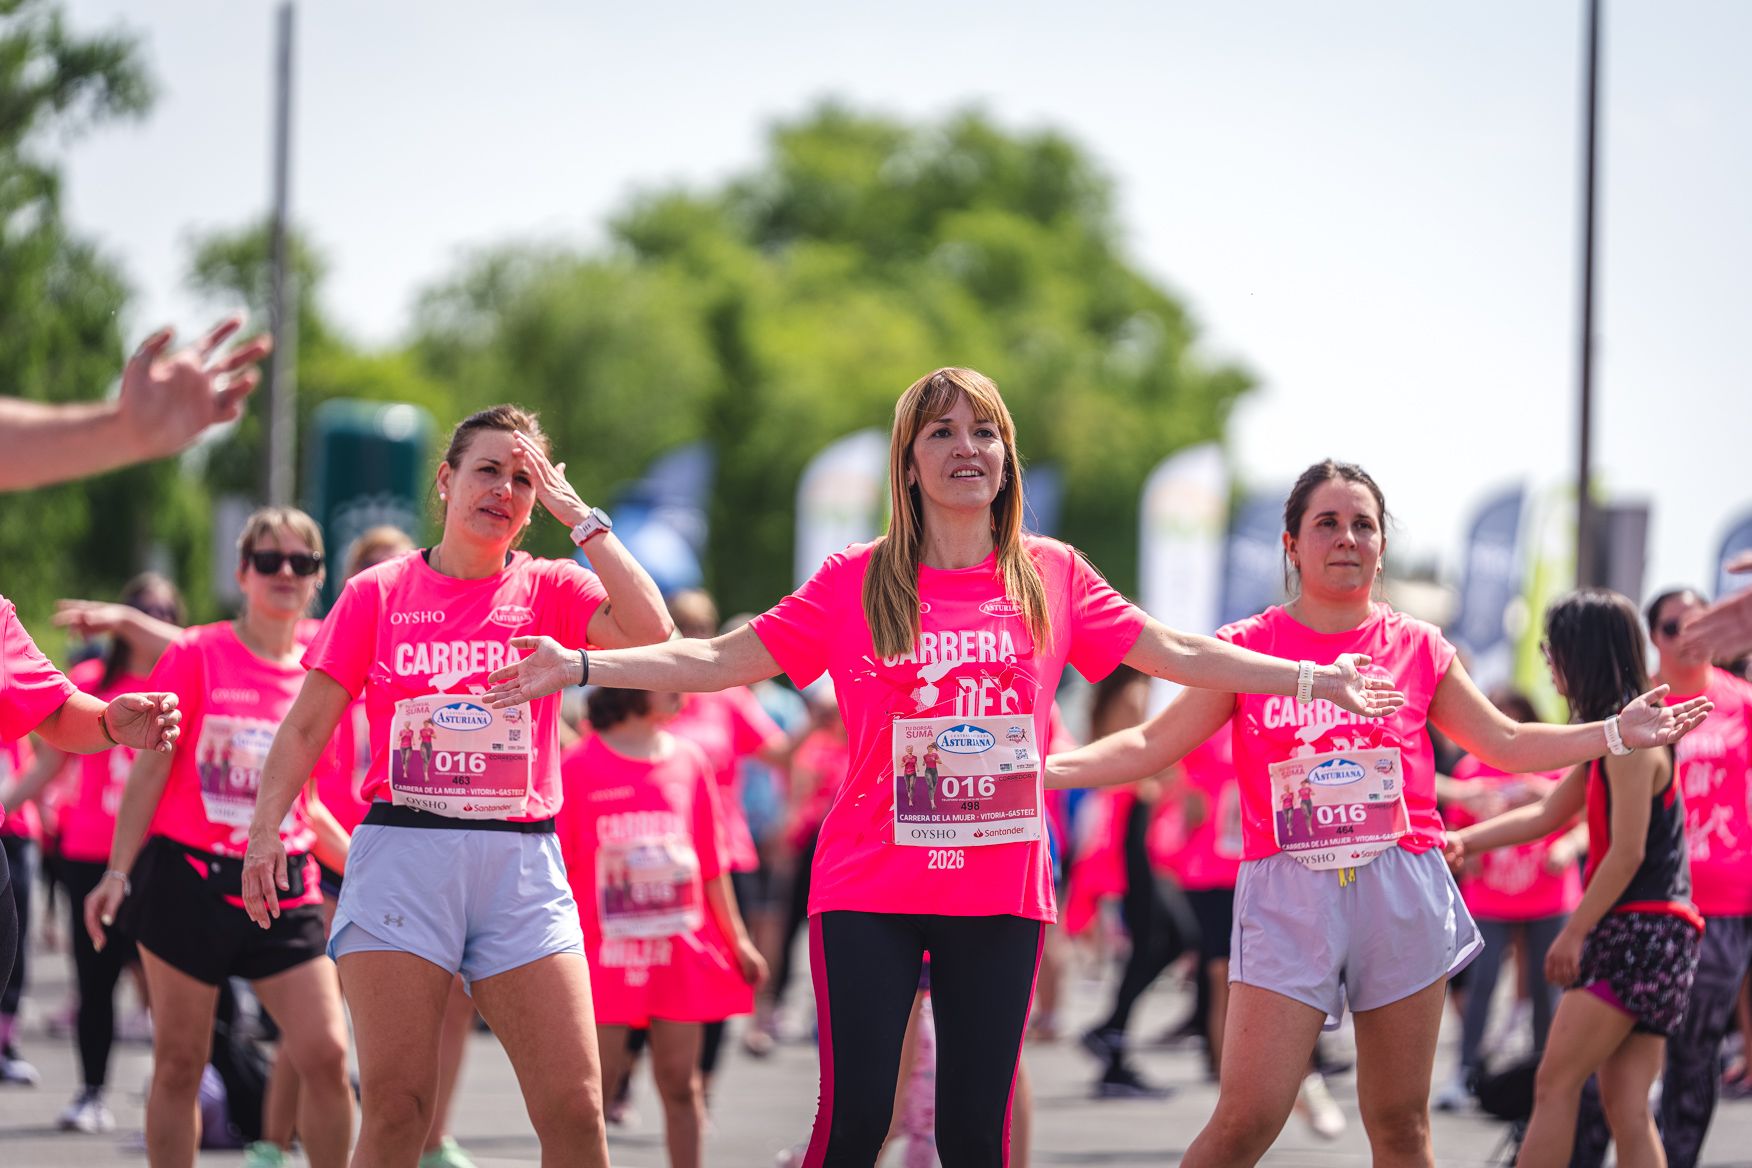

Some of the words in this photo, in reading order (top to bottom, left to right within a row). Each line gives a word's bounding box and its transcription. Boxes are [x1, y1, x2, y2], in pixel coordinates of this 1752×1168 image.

[390, 610, 446, 625] OYSHO
[437, 711, 488, 726] ASTURIANA
[906, 730, 934, 739] SUMA
[941, 735, 991, 747] ASTURIANA
[435, 751, 487, 773] 016
[452, 776, 471, 785] 463
[1313, 770, 1362, 781] ASTURIANA
[394, 784, 423, 794] CARRERA
[424, 786, 432, 794] DE
[433, 787, 442, 795] LA
[444, 787, 466, 795] MUJER
[471, 788, 525, 796] VITORIA-GASTEIZ
[941, 776, 996, 798] 016
[406, 796, 447, 810] OYSHO
[474, 804, 512, 812] Santander
[960, 801, 980, 811] 498
[900, 814, 931, 822] CARRERA
[932, 814, 941, 822] DE
[942, 814, 951, 822] LA
[952, 813, 976, 821] MUJER
[981, 808, 1035, 820] VITORIA-GASTEIZ
[1316, 803, 1367, 824] 016
[911, 829, 956, 839] OYSHO
[984, 826, 1025, 838] Santander
[1336, 825, 1354, 834] 464
[1311, 840, 1320, 848] DE
[1321, 839, 1330, 847] LA
[927, 849, 965, 870] 2026
[1295, 853, 1336, 864] OYSHO
